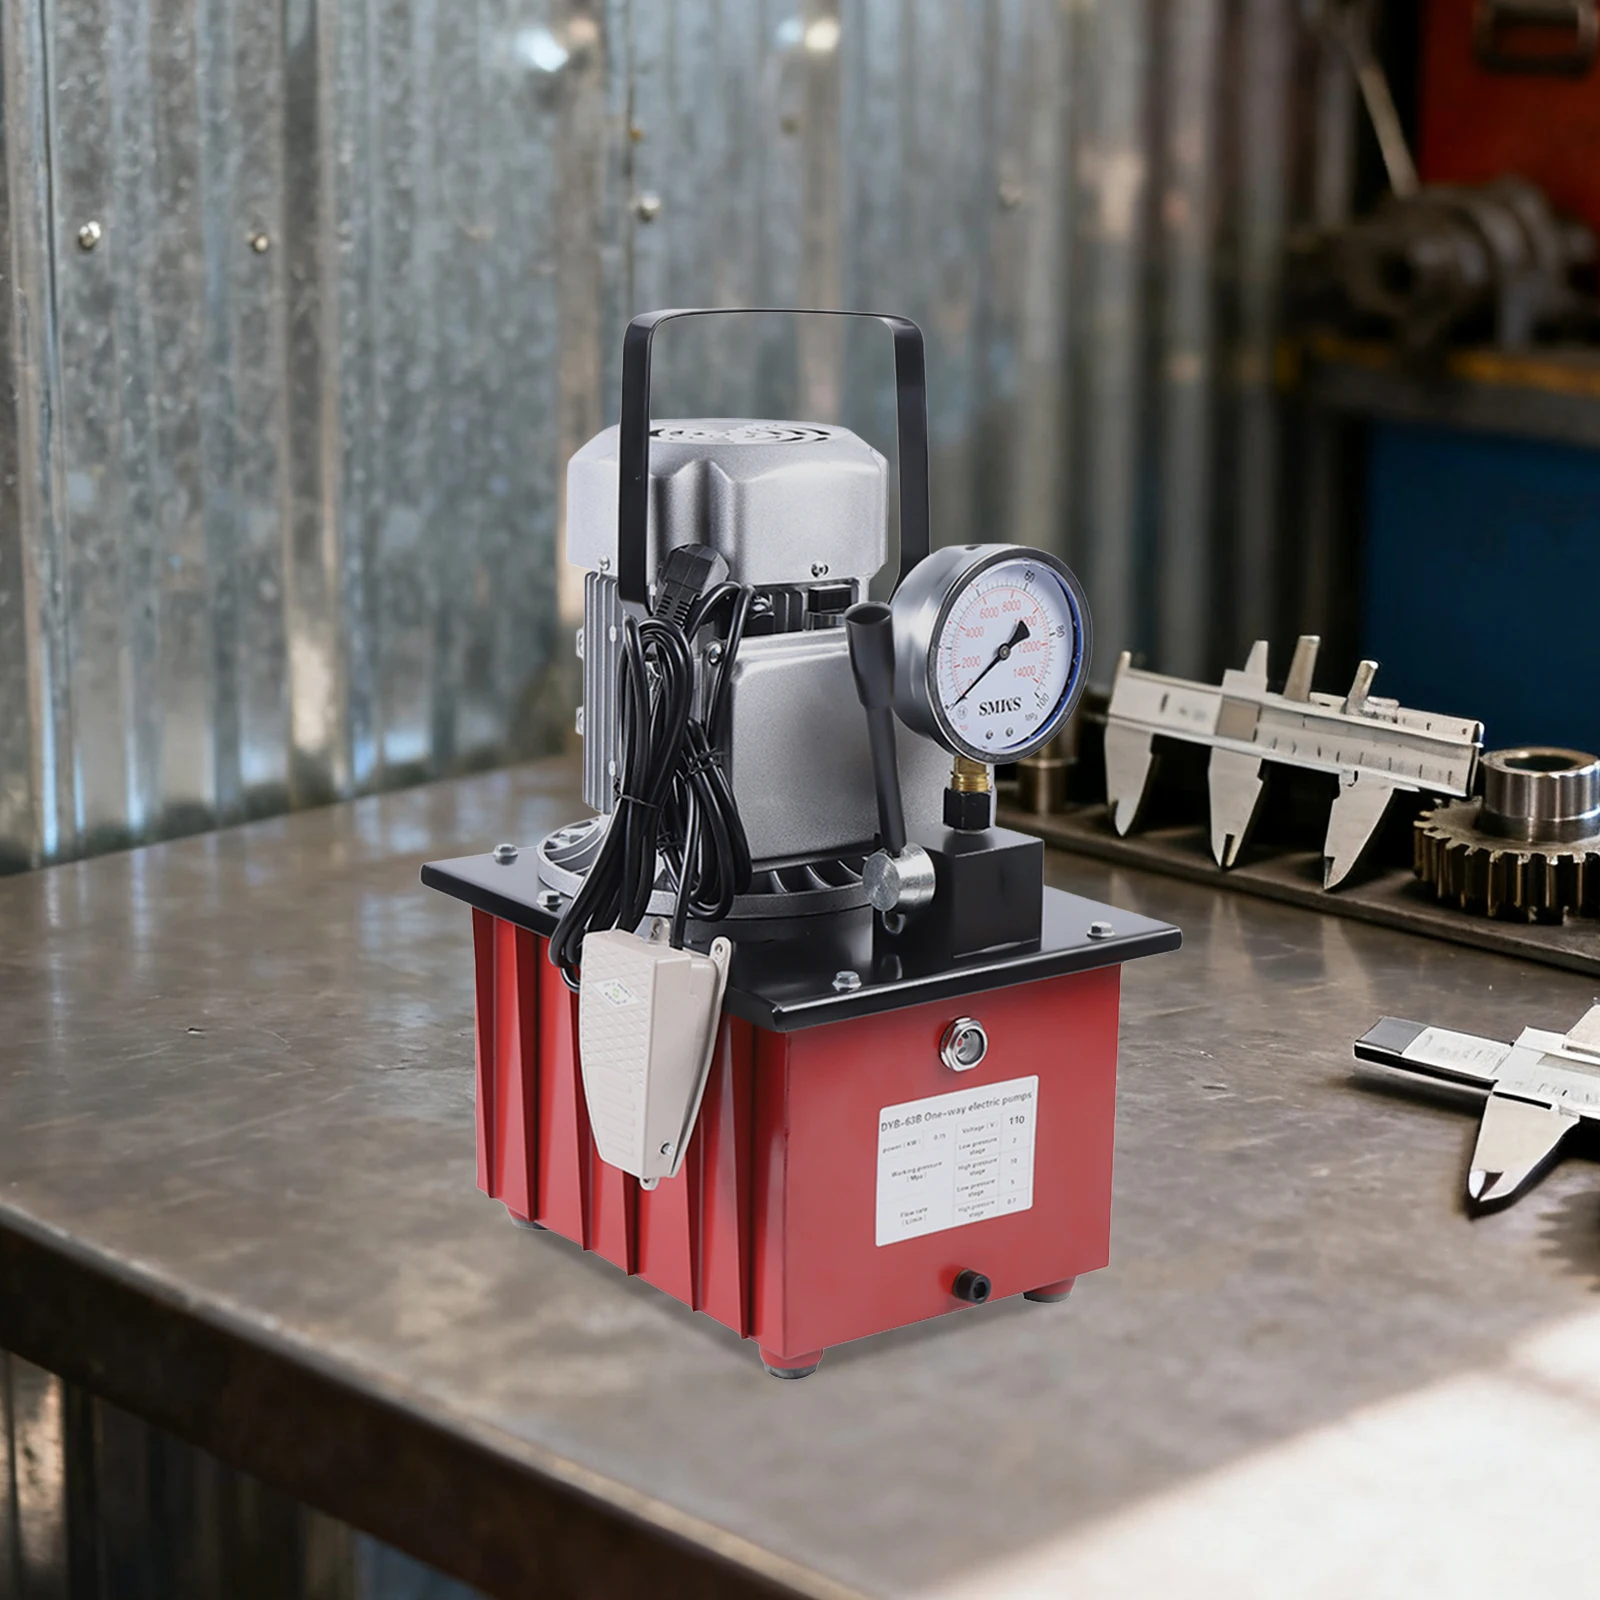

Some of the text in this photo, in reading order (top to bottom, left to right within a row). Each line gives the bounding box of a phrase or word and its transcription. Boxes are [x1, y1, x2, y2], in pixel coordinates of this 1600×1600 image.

[1002, 600, 1020, 613] 8000
[980, 607, 999, 619] 6000
[966, 627, 984, 638] 4000
[1018, 641, 1041, 653] 12000
[962, 656, 980, 668] 2000
[1014, 665, 1036, 677] 14000
[1036, 693, 1050, 709] 100
[881, 1091, 1032, 1132] DYB-63B One-way electric pumps
[1010, 1116, 1024, 1125] 110
